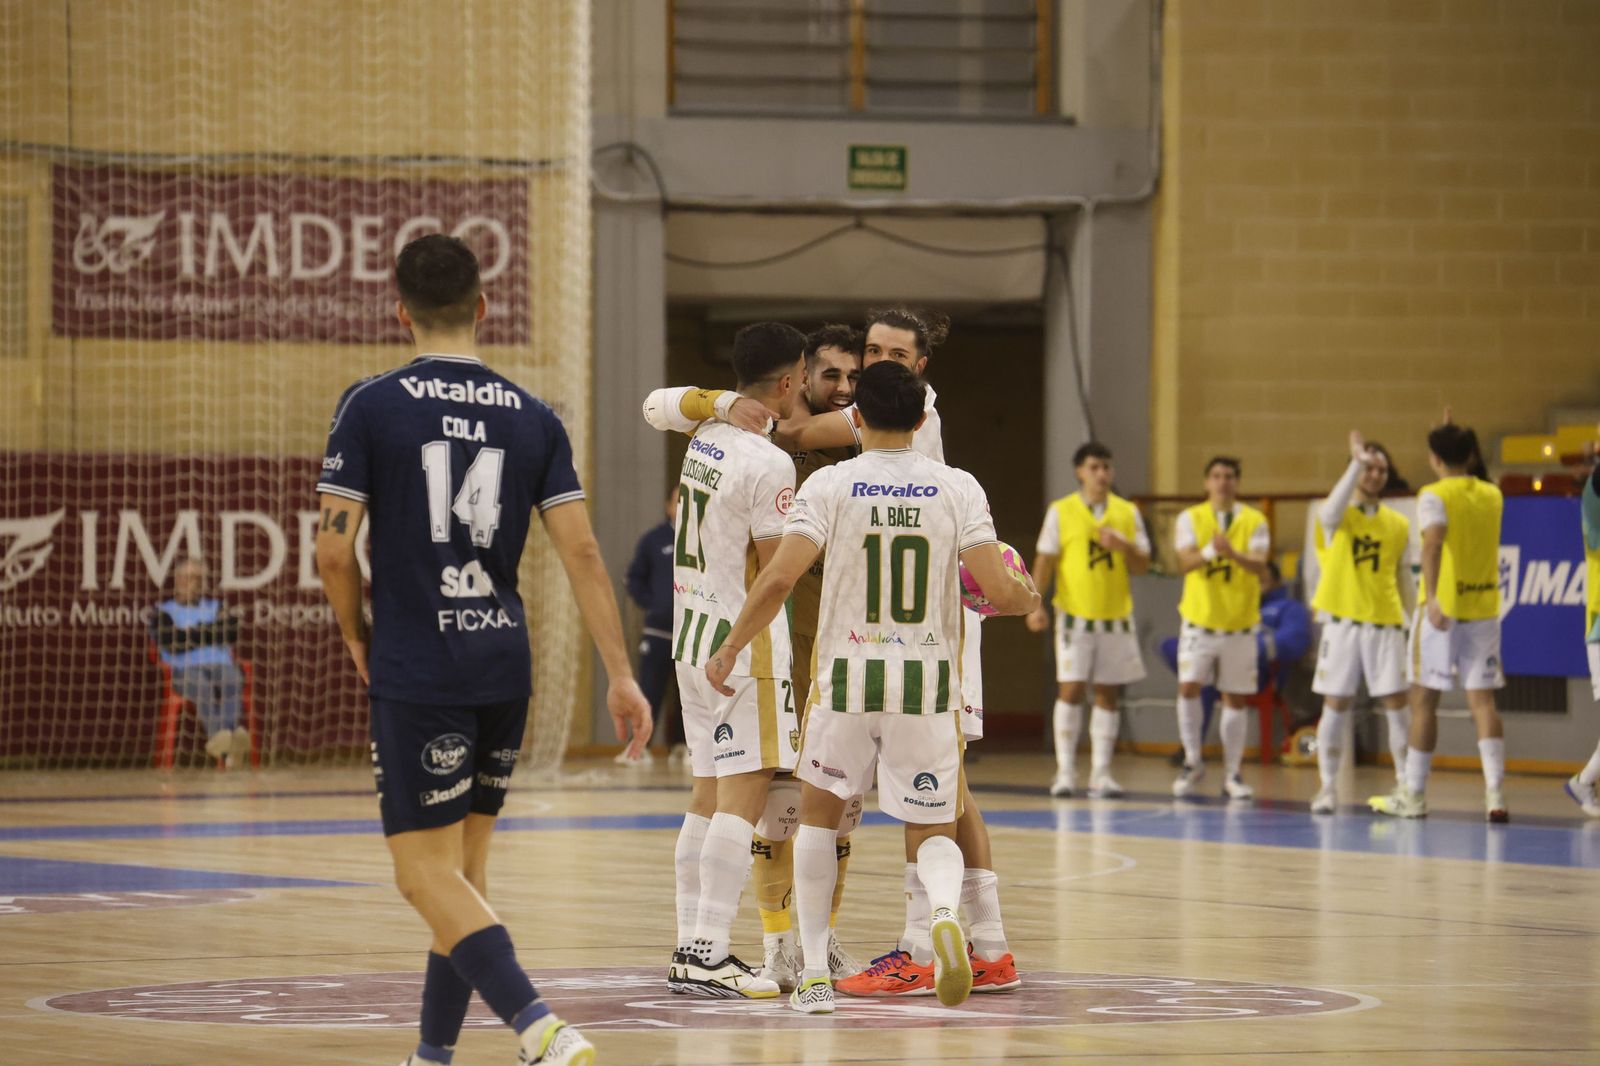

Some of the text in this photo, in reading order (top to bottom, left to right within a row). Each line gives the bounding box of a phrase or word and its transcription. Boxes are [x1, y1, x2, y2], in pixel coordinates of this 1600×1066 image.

[400, 376, 521, 409] Vitaldin
[442, 416, 487, 442] COLA
[322, 451, 345, 471] esh
[690, 435, 725, 461] evalco
[422, 441, 505, 549] 14
[852, 482, 938, 498] Revalco
[870, 504, 921, 528] A. BÁEZ
[863, 533, 930, 624] 10
[781, 680, 794, 713] 2
[904, 796, 947, 808] ROSMARINO
